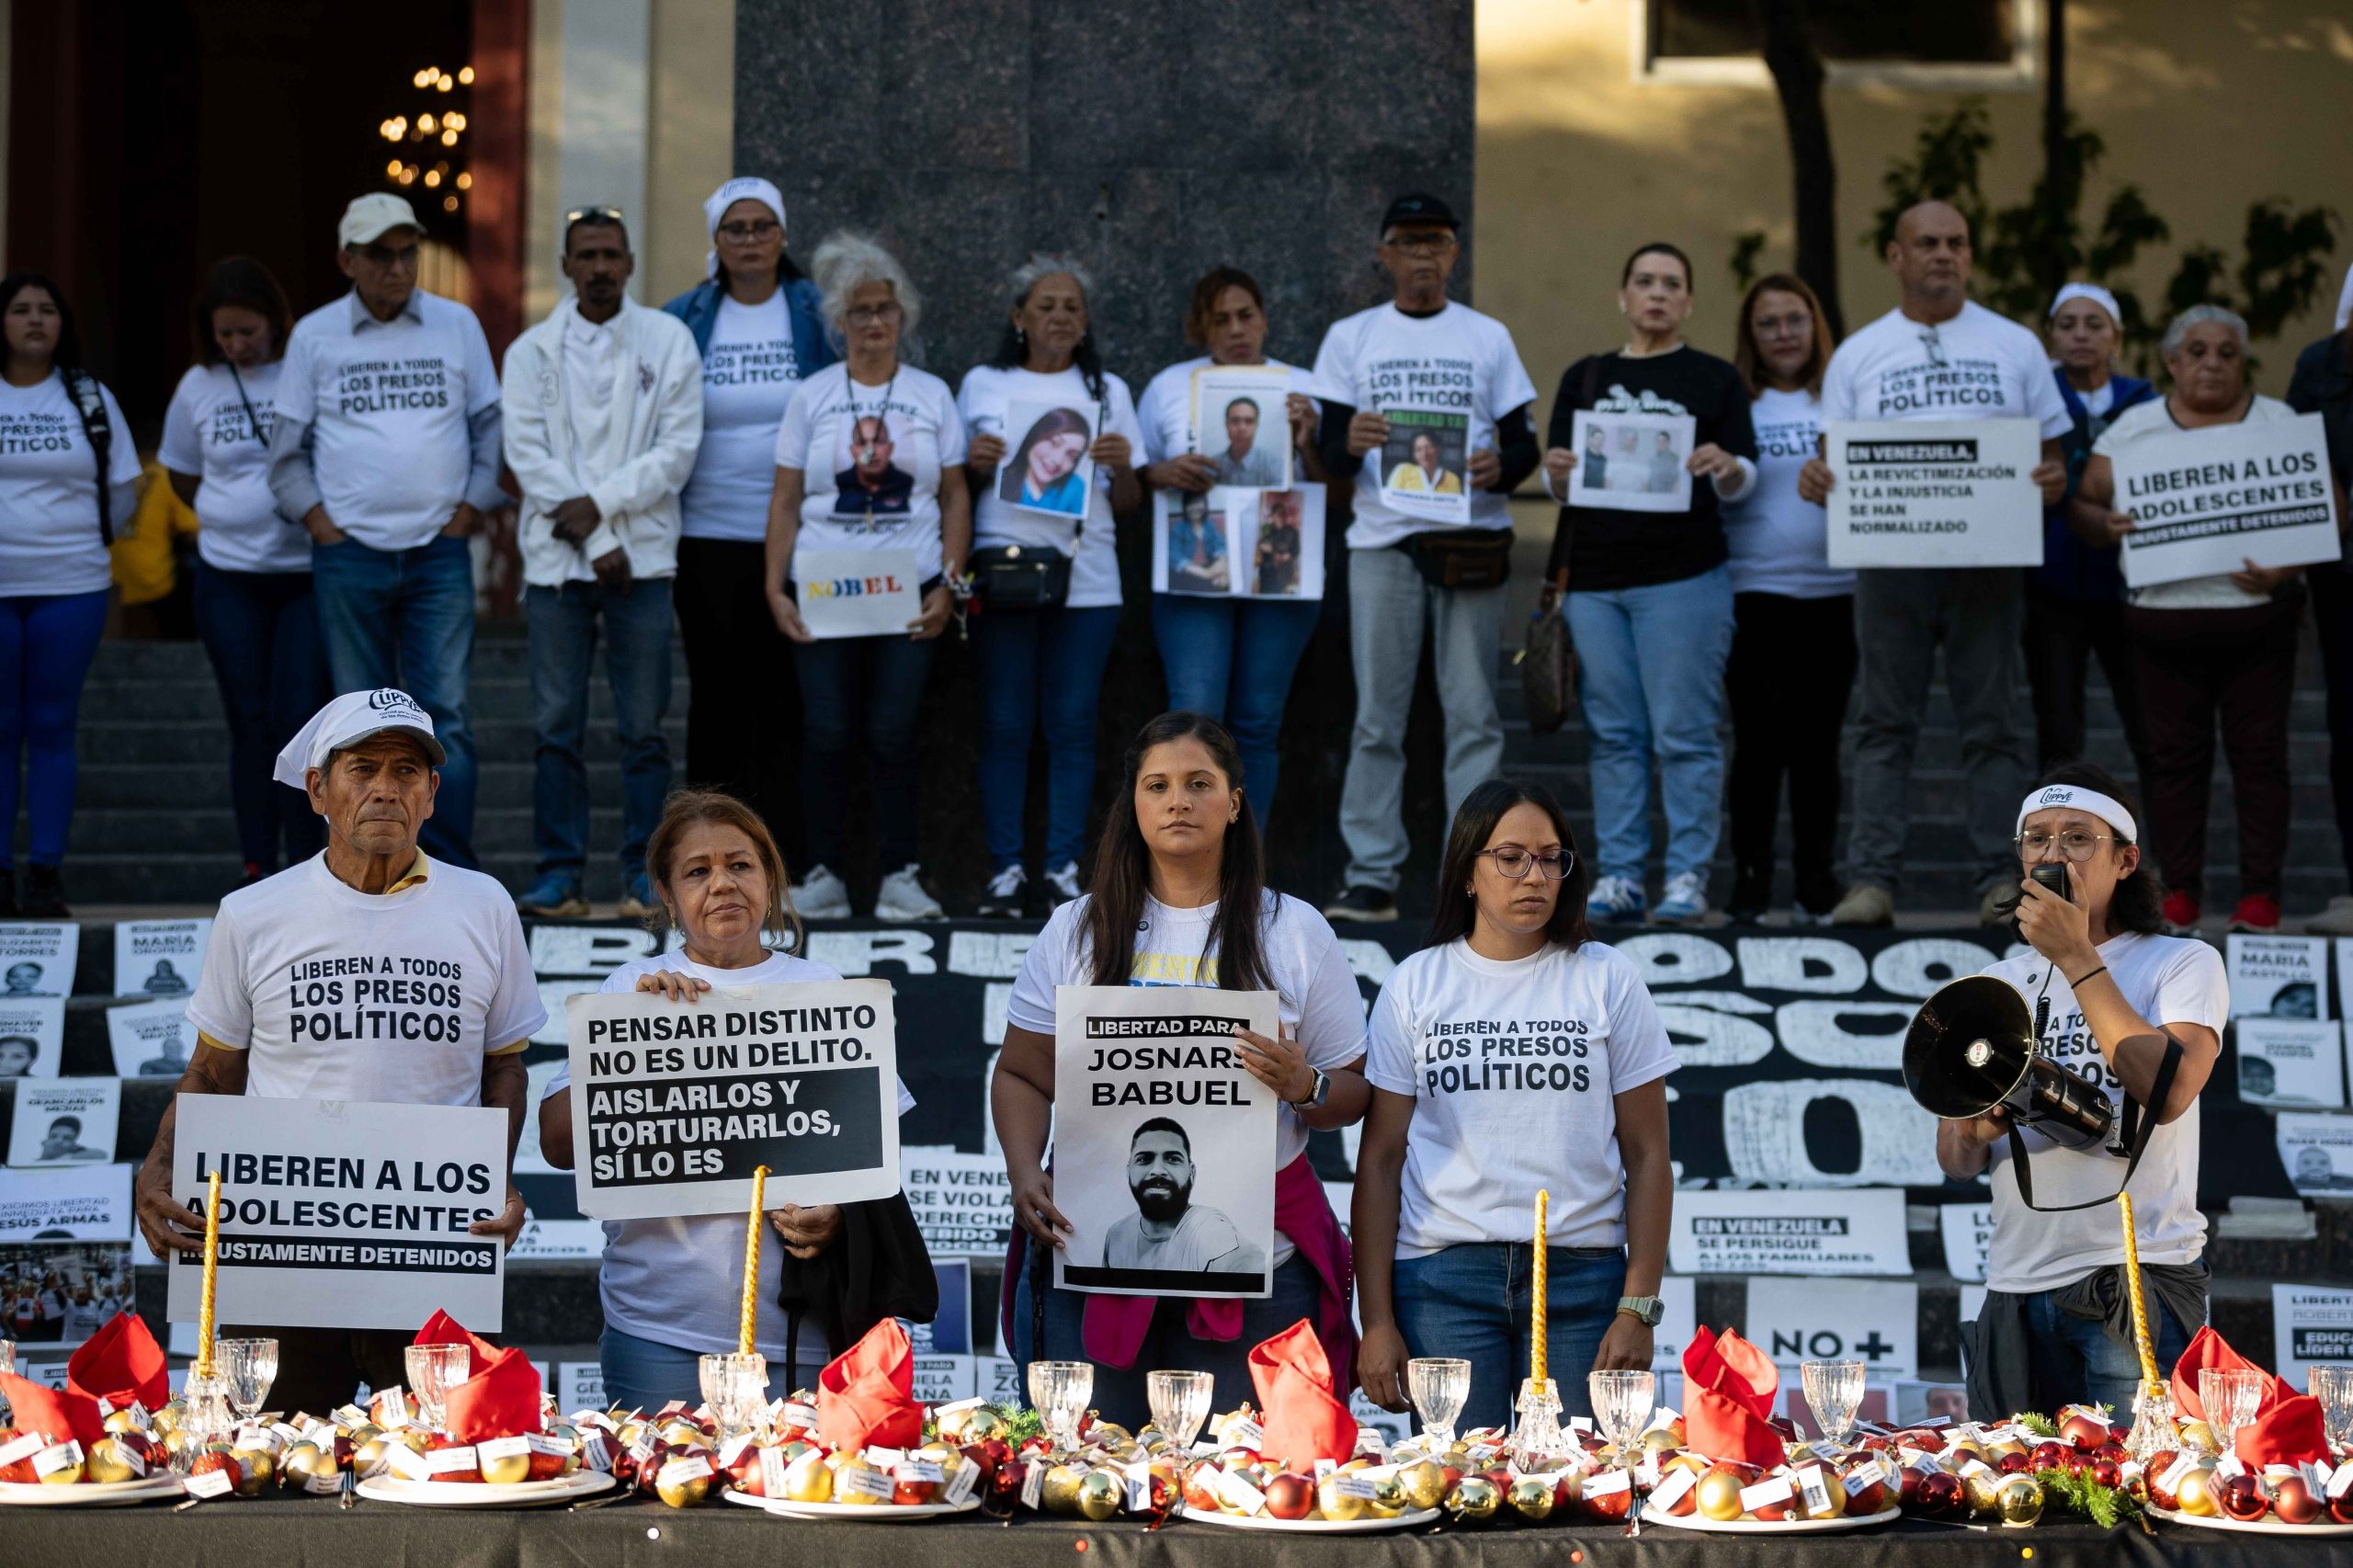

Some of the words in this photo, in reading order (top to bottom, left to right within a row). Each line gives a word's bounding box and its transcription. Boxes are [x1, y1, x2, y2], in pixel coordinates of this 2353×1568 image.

[742, 352, 798, 366] PRESO
[340, 373, 373, 394] LOS
[378, 371, 447, 392] PRESOS
[703, 367, 801, 385] POLÍTICO
[1370, 373, 1402, 390] LOS
[1407, 371, 1473, 389] PRESOS
[1925, 371, 2001, 387] PRESOS
[340, 391, 449, 415] POLÍTICOS
[1879, 387, 2006, 415] POLÍTICOS
[0, 436, 73, 454] ÍTICOS
[1849, 444, 1870, 460] EN
[1849, 469, 1869, 482] LA
[1873, 465, 2016, 481] REVICTIMIZACIÓN
[2128, 462, 2236, 497] LIBEREN
[2243, 460, 2260, 480] A
[2267, 451, 2318, 477] LOS
[1849, 488, 1859, 499] Y
[1862, 486, 1882, 499] LA
[1887, 485, 1973, 498] INJUSTICIA
[1849, 505, 1869, 517] SE
[1873, 504, 1906, 516] HAN
[2127, 480, 2325, 523] ADOLESCENTES
[1849, 520, 1968, 534] NORMALIZADO
[2241, 506, 2328, 530] DETENIDOS
[809, 575, 903, 599] NOBEL
[290, 956, 373, 982] LIBEREN
[380, 956, 394, 974] A
[400, 958, 461, 981] TODOS
[290, 981, 344, 1008] LOS
[355, 979, 461, 1009] PRESOS
[290, 1005, 461, 1043] POLÍTICOS
[588, 1013, 716, 1044] PENSAR
[725, 1005, 877, 1037] DISTINTO
[1087, 1019, 1185, 1036] LIBERTAD
[1189, 1018, 1242, 1034] PARA
[1426, 1019, 1501, 1039] LIBEREN
[1506, 1020, 1520, 1034] A
[1526, 1019, 1588, 1035] TODOS
[2049, 1017, 2060, 1031] A
[1426, 1038, 1472, 1064] LOS
[1481, 1036, 1588, 1058] PRESOS
[2040, 1032, 2102, 1058] RESO
[590, 1050, 637, 1076] NO
[645, 1046, 685, 1074] ES
[693, 1044, 738, 1071] UN
[747, 1037, 873, 1068] DELITO.
[1426, 1057, 1590, 1097] POLÍTICOS
[591, 1081, 773, 1116] AISLARLOS
[779, 1079, 801, 1105] Y
[1091, 1080, 1251, 1107] BABUEL
[591, 1108, 841, 1148] TORTURARLOS,
[594, 1147, 628, 1180] SÍ
[633, 1152, 676, 1178] LO
[684, 1149, 724, 1176] ES
[196, 1152, 366, 1189] LIBEREN
[375, 1160, 403, 1192] A
[414, 1161, 491, 1195] LOS
[910, 1169, 940, 1185] EN
[947, 1169, 1009, 1187] VENE
[0, 1199, 51, 1210] XIGIMOS
[53, 1197, 110, 1207] LIBERTAD
[909, 1189, 938, 1206] SE
[70, 1205, 101, 1214] PARA
[47, 1213, 111, 1228] ARMAS
[1696, 1219, 1722, 1233] EN
[1724, 1219, 1844, 1233] VENEZUELA
[922, 1227, 998, 1242] EBIDO
[1698, 1237, 1721, 1250] SE
[1725, 1237, 1823, 1250] PERSIGUE
[183, 1243, 356, 1264] USTAMENTE
[359, 1245, 493, 1267] DETENIDOS
[1699, 1252, 1711, 1261] A
[1715, 1252, 1753, 1262] LOS
[1757, 1252, 1875, 1263] FAMILIARES
[2291, 1295, 2353, 1305] LIBERT
[1772, 1329, 1844, 1358] NO
[2305, 1332, 2353, 1345] EDUC
[46, 1369, 69, 1378] LIBE
[926, 1360, 953, 1369] PARA
[577, 1395, 606, 1404] ROD
